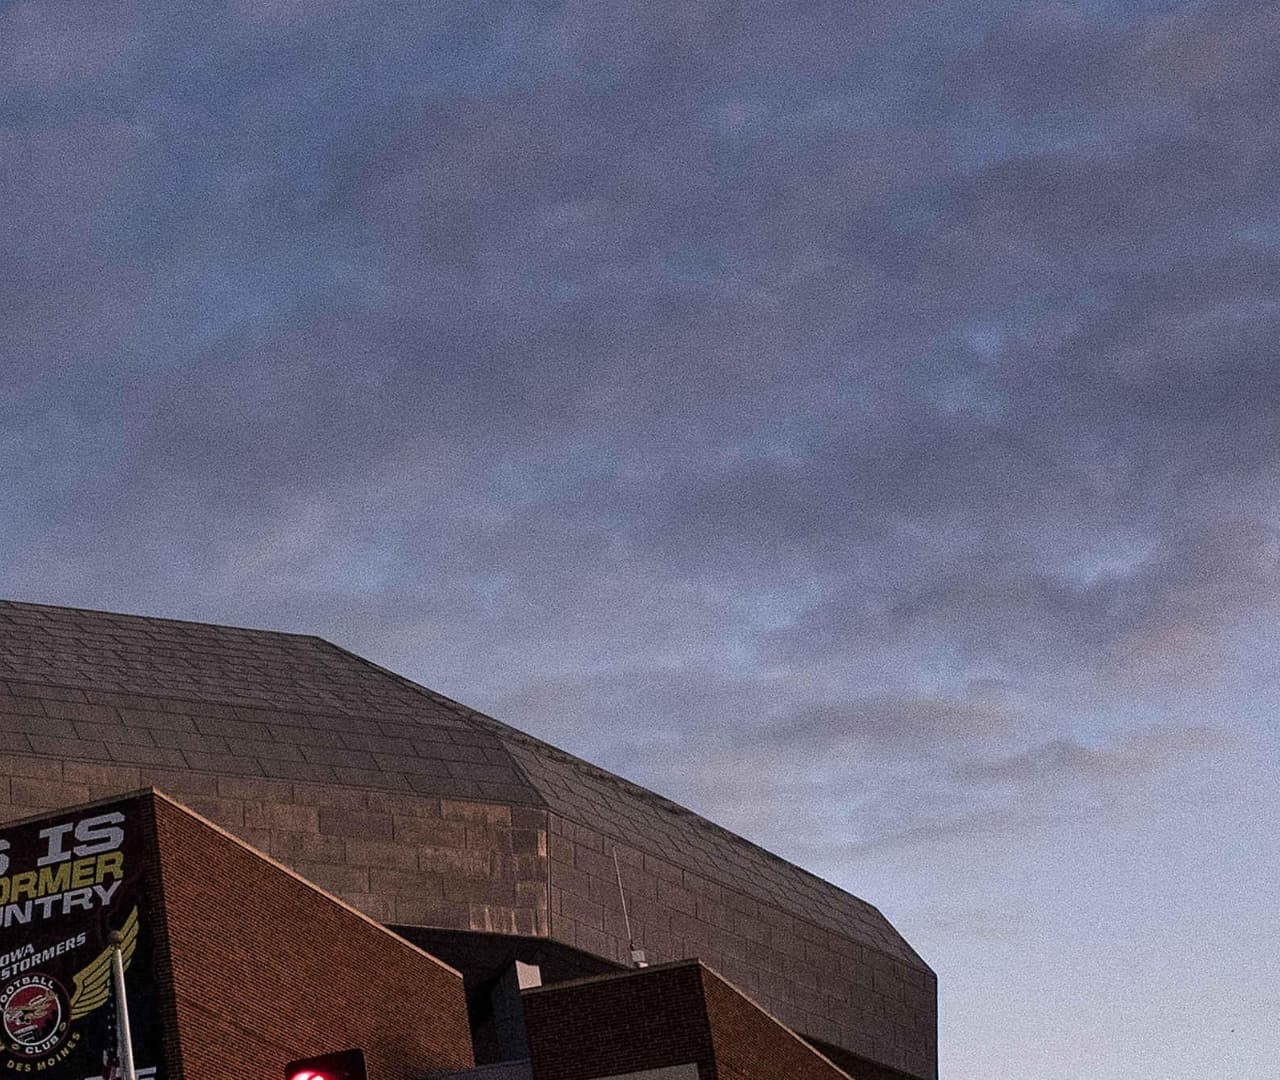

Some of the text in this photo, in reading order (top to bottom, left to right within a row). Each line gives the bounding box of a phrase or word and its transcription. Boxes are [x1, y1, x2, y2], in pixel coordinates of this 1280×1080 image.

[37, 810, 127, 867] IS
[6, 1032, 81, 1072] DES MOINES
[25, 1036, 60, 1055] CLUB
